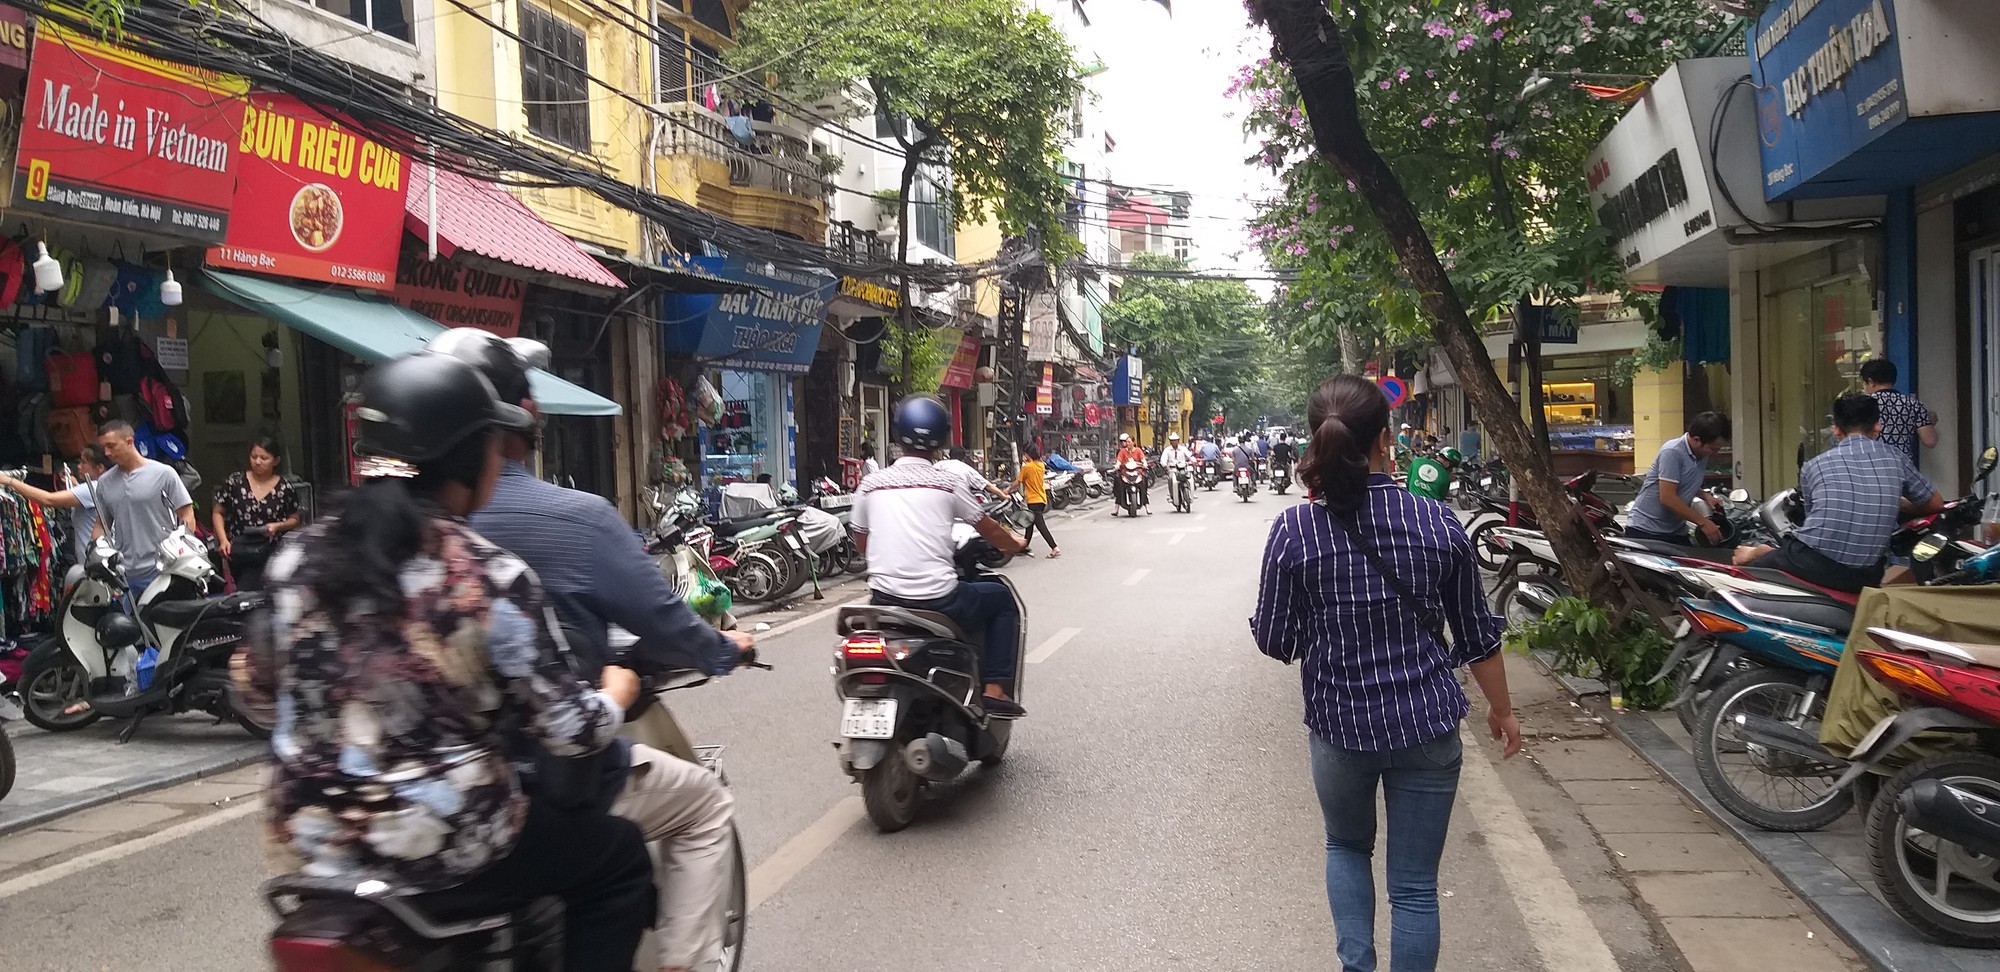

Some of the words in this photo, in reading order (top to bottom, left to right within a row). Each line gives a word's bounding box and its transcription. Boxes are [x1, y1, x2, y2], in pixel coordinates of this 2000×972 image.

[37, 78, 109, 144] Made
[113, 99, 136, 151] in
[145, 106, 229, 173] Vietnam
[31, 166, 45, 197] 9
[358, 140, 401, 192] CUA
[219, 247, 231, 261] 11
[233, 248, 258, 267] Hàng
[259, 253, 276, 269] Bạc
[463, 266, 520, 299] QUILTS
[753, 289, 800, 322] TRANG
